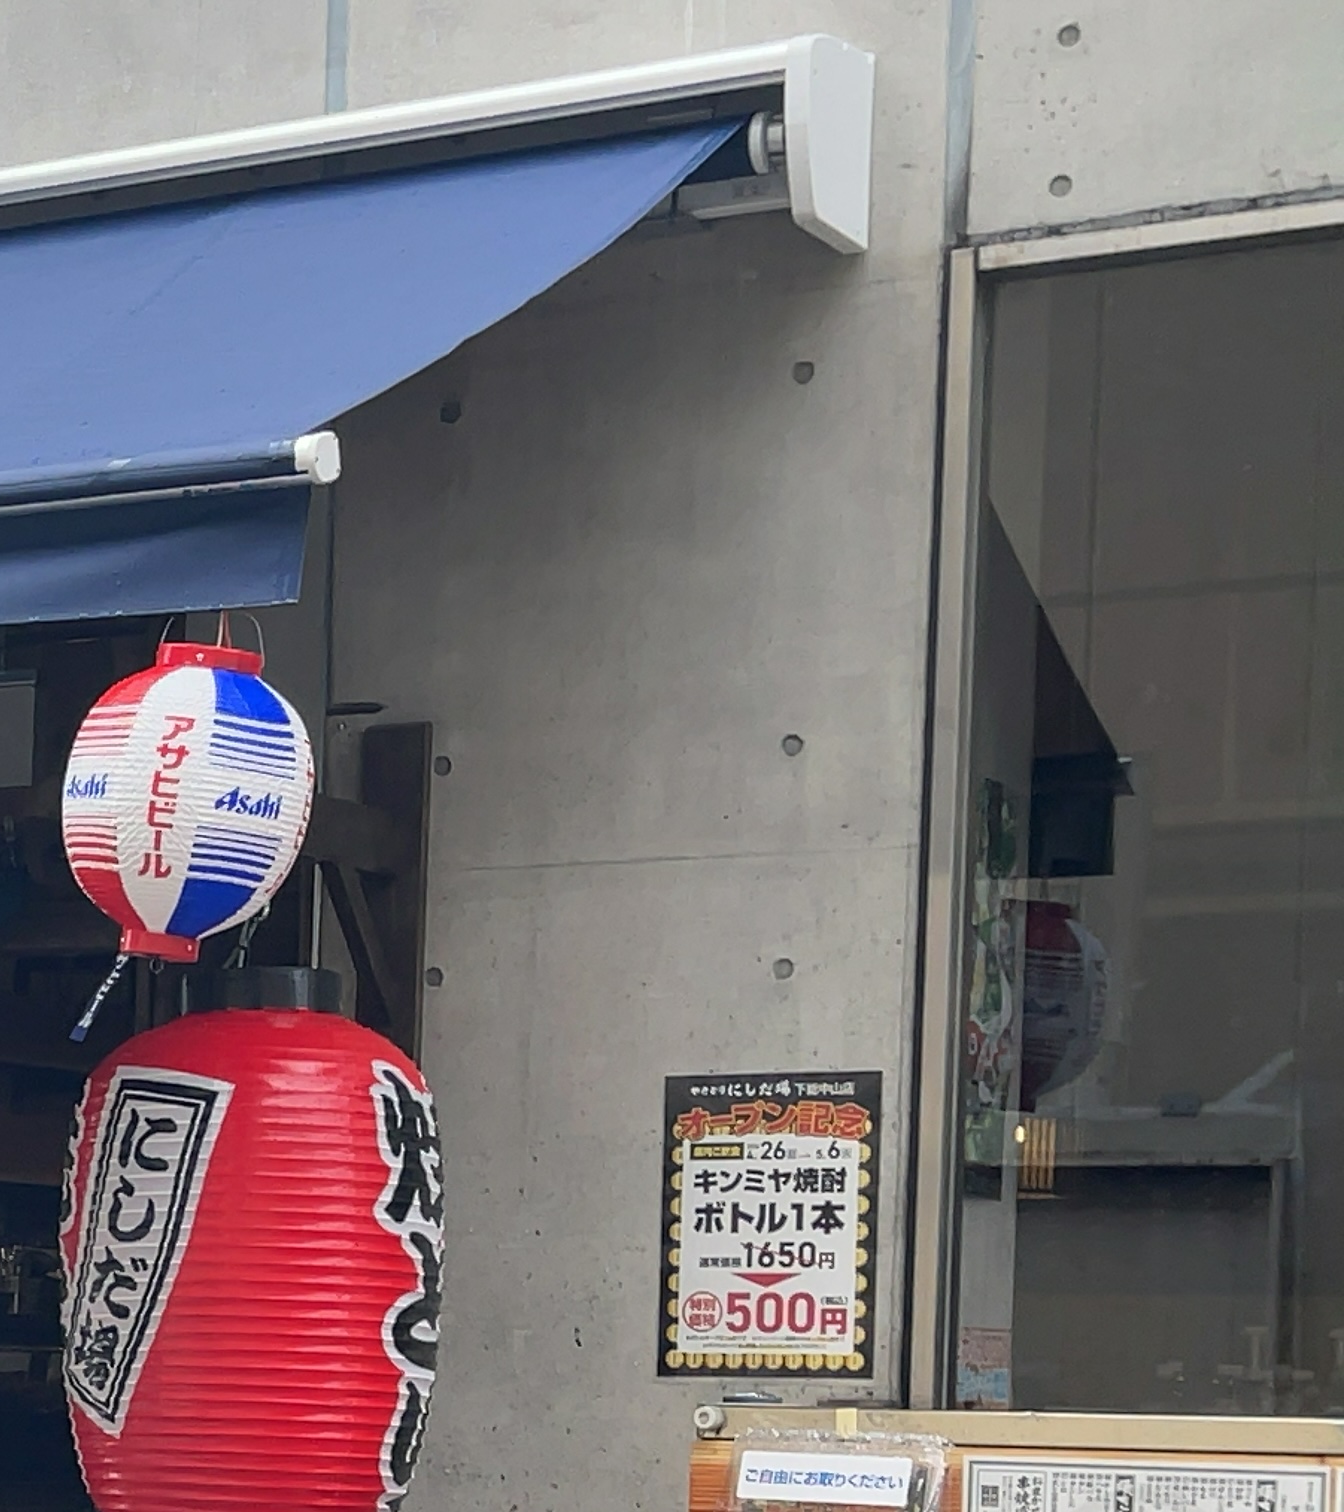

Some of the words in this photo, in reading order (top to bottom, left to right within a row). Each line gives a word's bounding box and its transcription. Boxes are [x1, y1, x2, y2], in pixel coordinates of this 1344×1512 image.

[138, 715, 195, 878] アサヒビール
[214, 786, 283, 820] Asahi
[677, 1100, 869, 1140] オープン記念
[694, 1167, 847, 1193] キンミヤ焼酎
[694, 1201, 846, 1235] ボトル1本
[75, 1108, 177, 1391] にしだ場
[742, 1242, 836, 1269] 1650円
[726, 1291, 848, 1335] 500円
[745, 1468, 904, 1489] ご自由にお取りください
